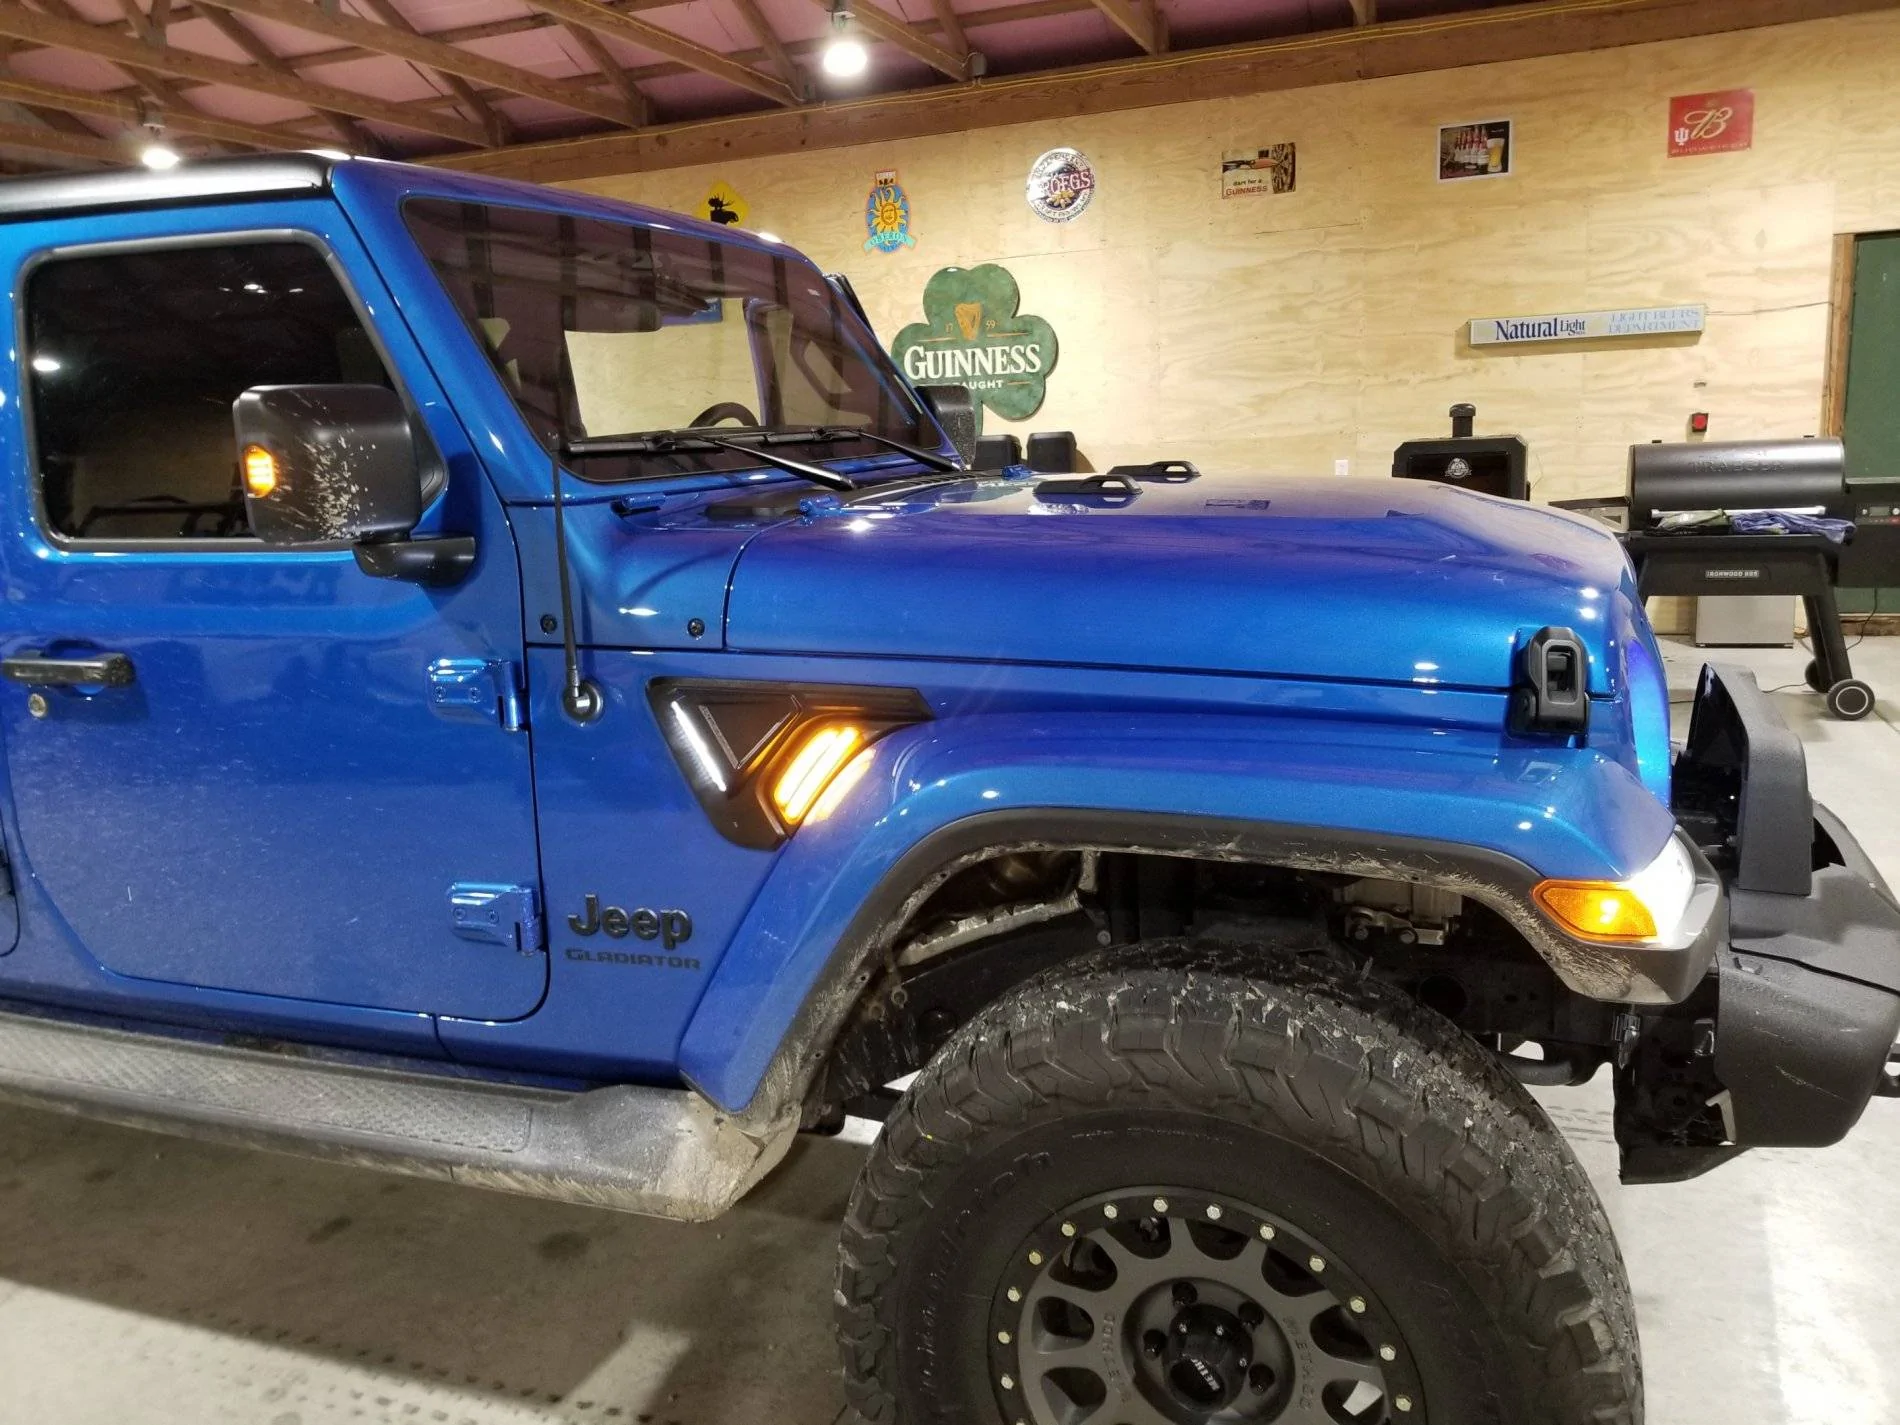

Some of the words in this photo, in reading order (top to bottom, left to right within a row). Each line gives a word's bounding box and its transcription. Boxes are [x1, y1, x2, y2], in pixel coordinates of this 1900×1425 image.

[1226, 186, 1267, 196] GUINNESS
[985, 319, 996, 330] 59
[1496, 317, 1558, 341] Natural
[1559, 319, 1586, 337] Light
[903, 343, 1042, 380] GUINNESS
[567, 893, 693, 950] Jeep
[565, 948, 701, 969] GLADIATOR
